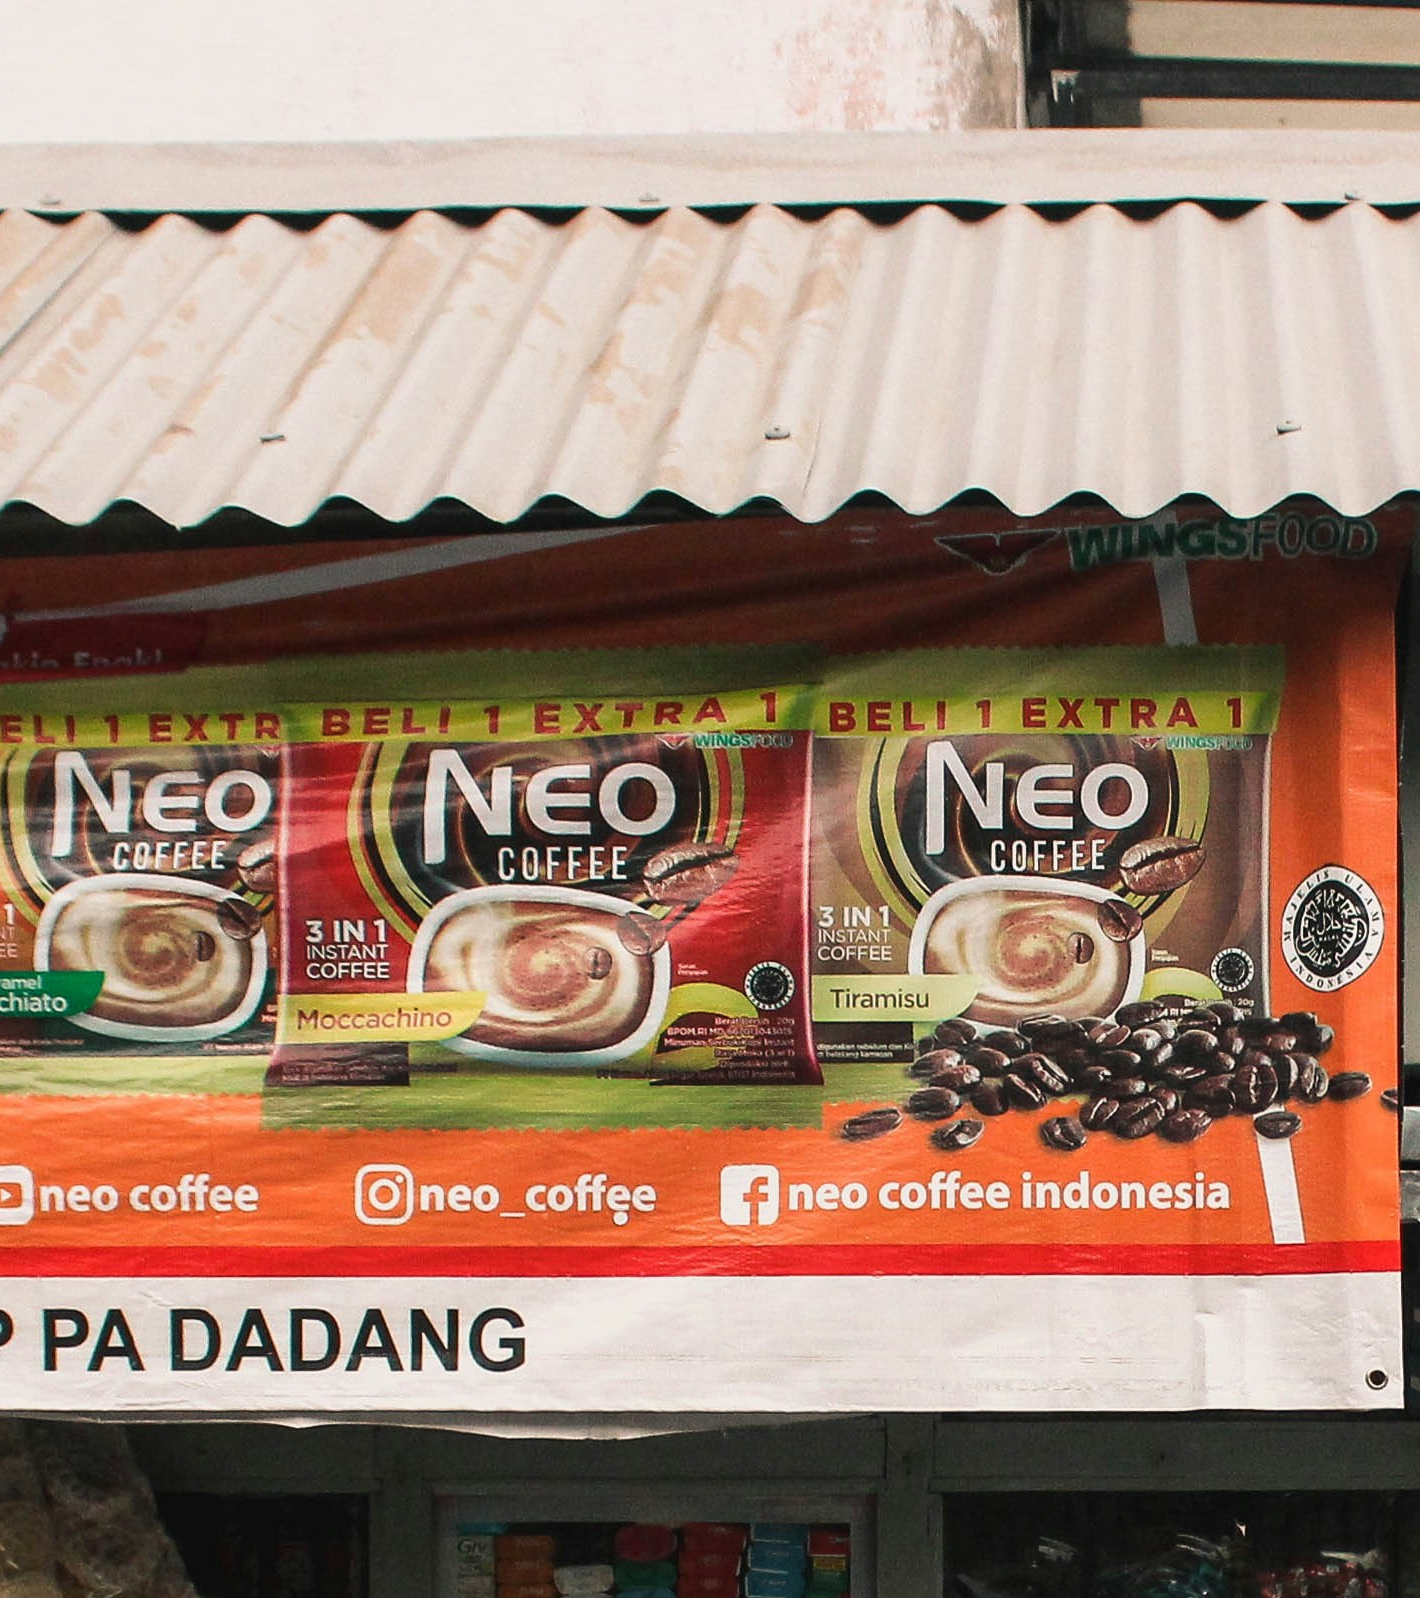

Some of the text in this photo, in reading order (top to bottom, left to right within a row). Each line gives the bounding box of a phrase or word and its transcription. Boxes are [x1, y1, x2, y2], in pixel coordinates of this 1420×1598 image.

[104, 714, 120, 743] 1
[322, 691, 778, 737] BELI 1 EXTRA 1
[829, 697, 1244, 732] BELI 1 EXTRA 1
[50, 750, 273, 859] NEO
[423, 748, 677, 866] NEO
[924, 740, 1149, 856] NEO
[112, 839, 227, 872] COFFEE
[498, 845, 628, 882] COFFEE
[989, 838, 1107, 874] COFFEE
[4, 903, 16, 926] 1
[817, 905, 892, 928] 3 IN 1
[1283, 869, 1330, 942] MAJELIS
[1344, 873, 1381, 938] ULAMA
[305, 919, 388, 943] 3 IN 1
[817, 927, 893, 945] INSTANT
[306, 943, 389, 961] INSTANT
[817, 945, 893, 962] COFFEE
[1289, 950, 1374, 989] INDONESIA
[306, 961, 390, 980] COFFEE
[829, 988, 930, 1011] Tiramisu
[296, 1007, 453, 1032] Moccachino
[39, 1173, 259, 1213] neo coffee
[419, 1173, 657, 1218] neo_coffee
[788, 1171, 1230, 1211] neo coffee indonesia
[43, 1307, 144, 1373] PA
[170, 1307, 528, 1374] DADANG
